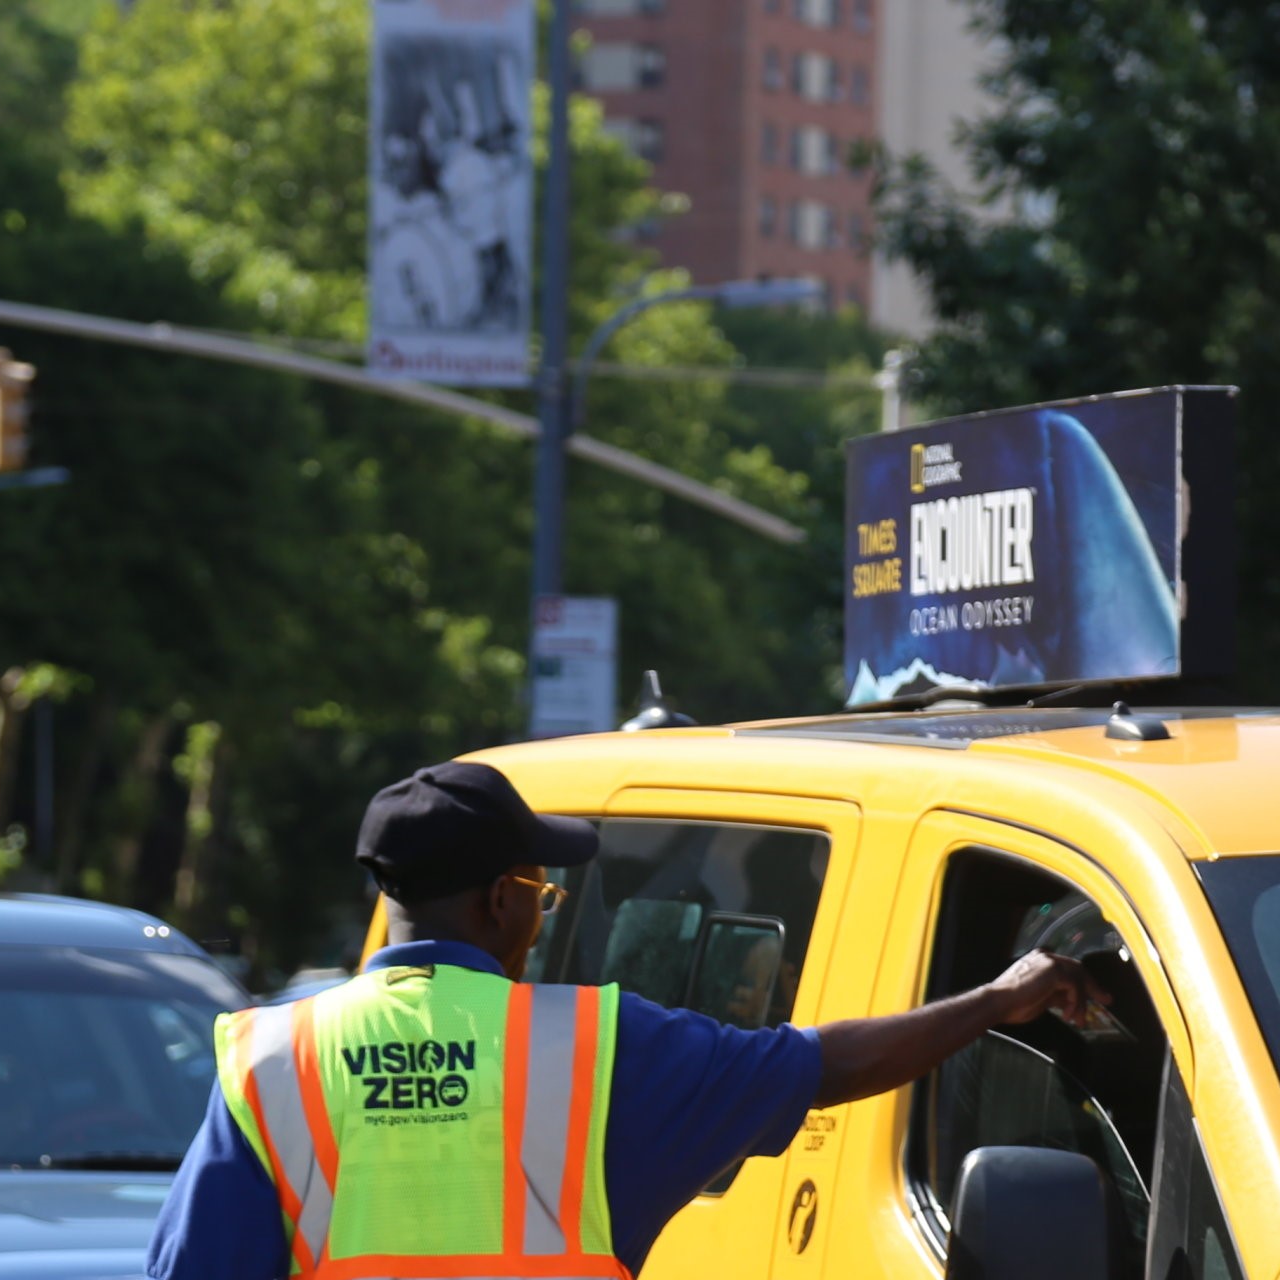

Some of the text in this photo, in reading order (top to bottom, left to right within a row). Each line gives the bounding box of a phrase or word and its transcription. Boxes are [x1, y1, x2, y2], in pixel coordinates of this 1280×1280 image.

[857, 518, 897, 557] TIMES
[910, 487, 1034, 597] ENCOUNTER
[853, 557, 902, 599] SQUARE
[909, 596, 1034, 637] OCEAN ODYSSEY
[341, 1040, 475, 1075] VISION
[362, 1074, 469, 1109] ZERO
